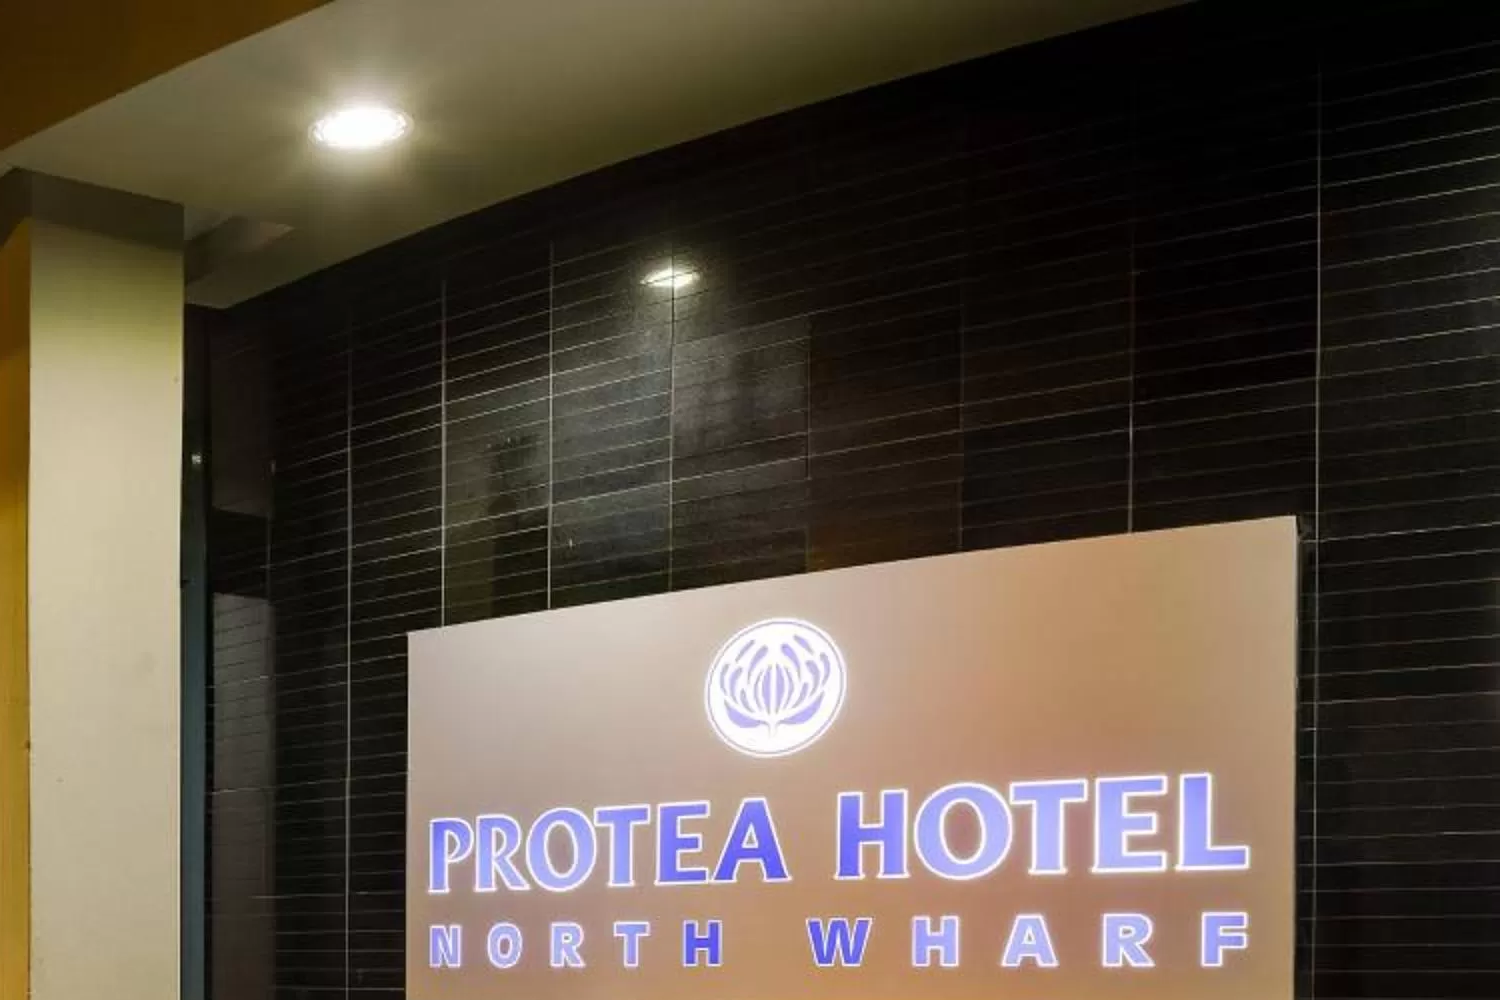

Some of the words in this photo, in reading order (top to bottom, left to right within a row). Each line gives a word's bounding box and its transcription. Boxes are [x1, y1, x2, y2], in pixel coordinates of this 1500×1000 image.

[428, 797, 792, 893] PROTEA
[834, 772, 1250, 880] HOTEL
[428, 919, 723, 969] NORTH
[805, 912, 1249, 967] WHARF
